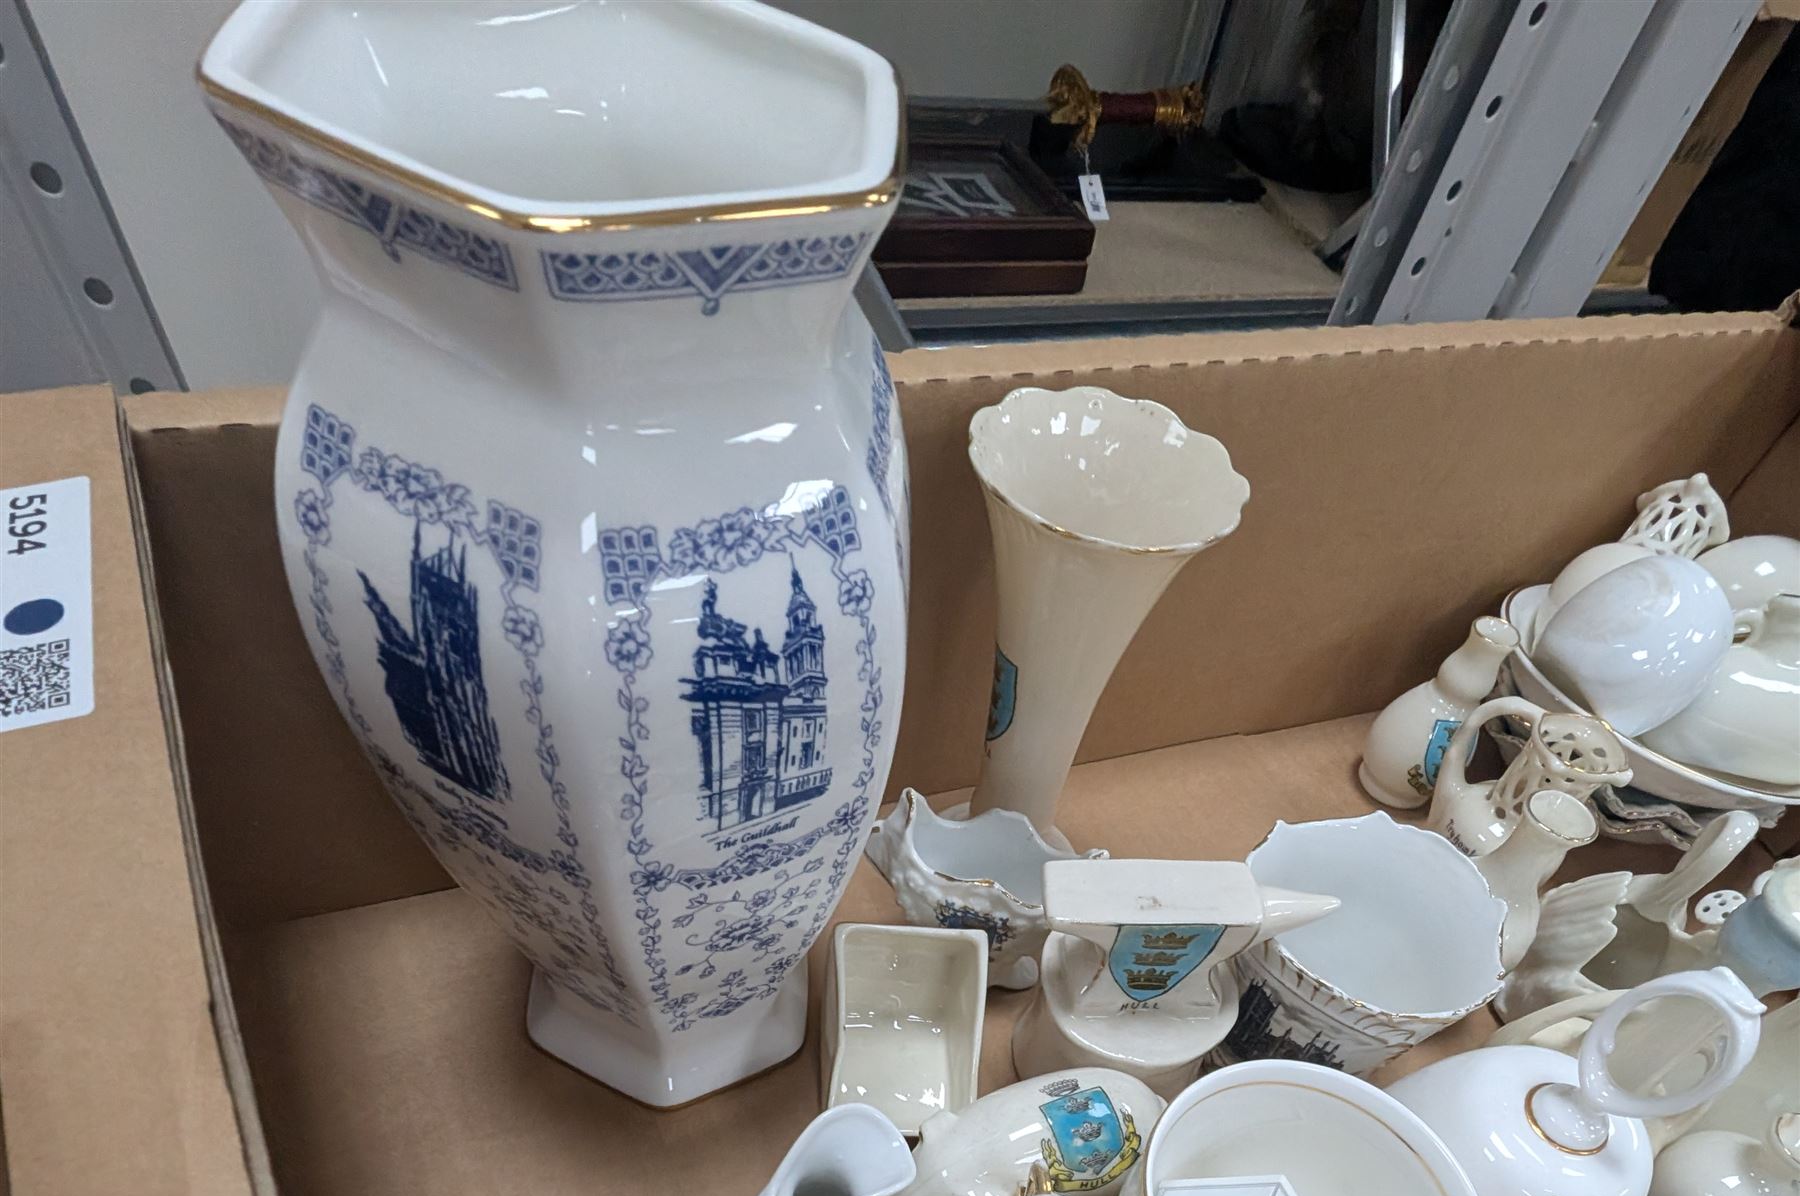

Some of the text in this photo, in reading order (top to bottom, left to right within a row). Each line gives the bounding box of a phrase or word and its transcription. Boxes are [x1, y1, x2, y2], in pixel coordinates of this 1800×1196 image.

[7, 493, 47, 555] 5194
[715, 815, 800, 852] The Guildhall
[1120, 1002, 1160, 1012] HULL
[1079, 1174, 1117, 1190] HULL
